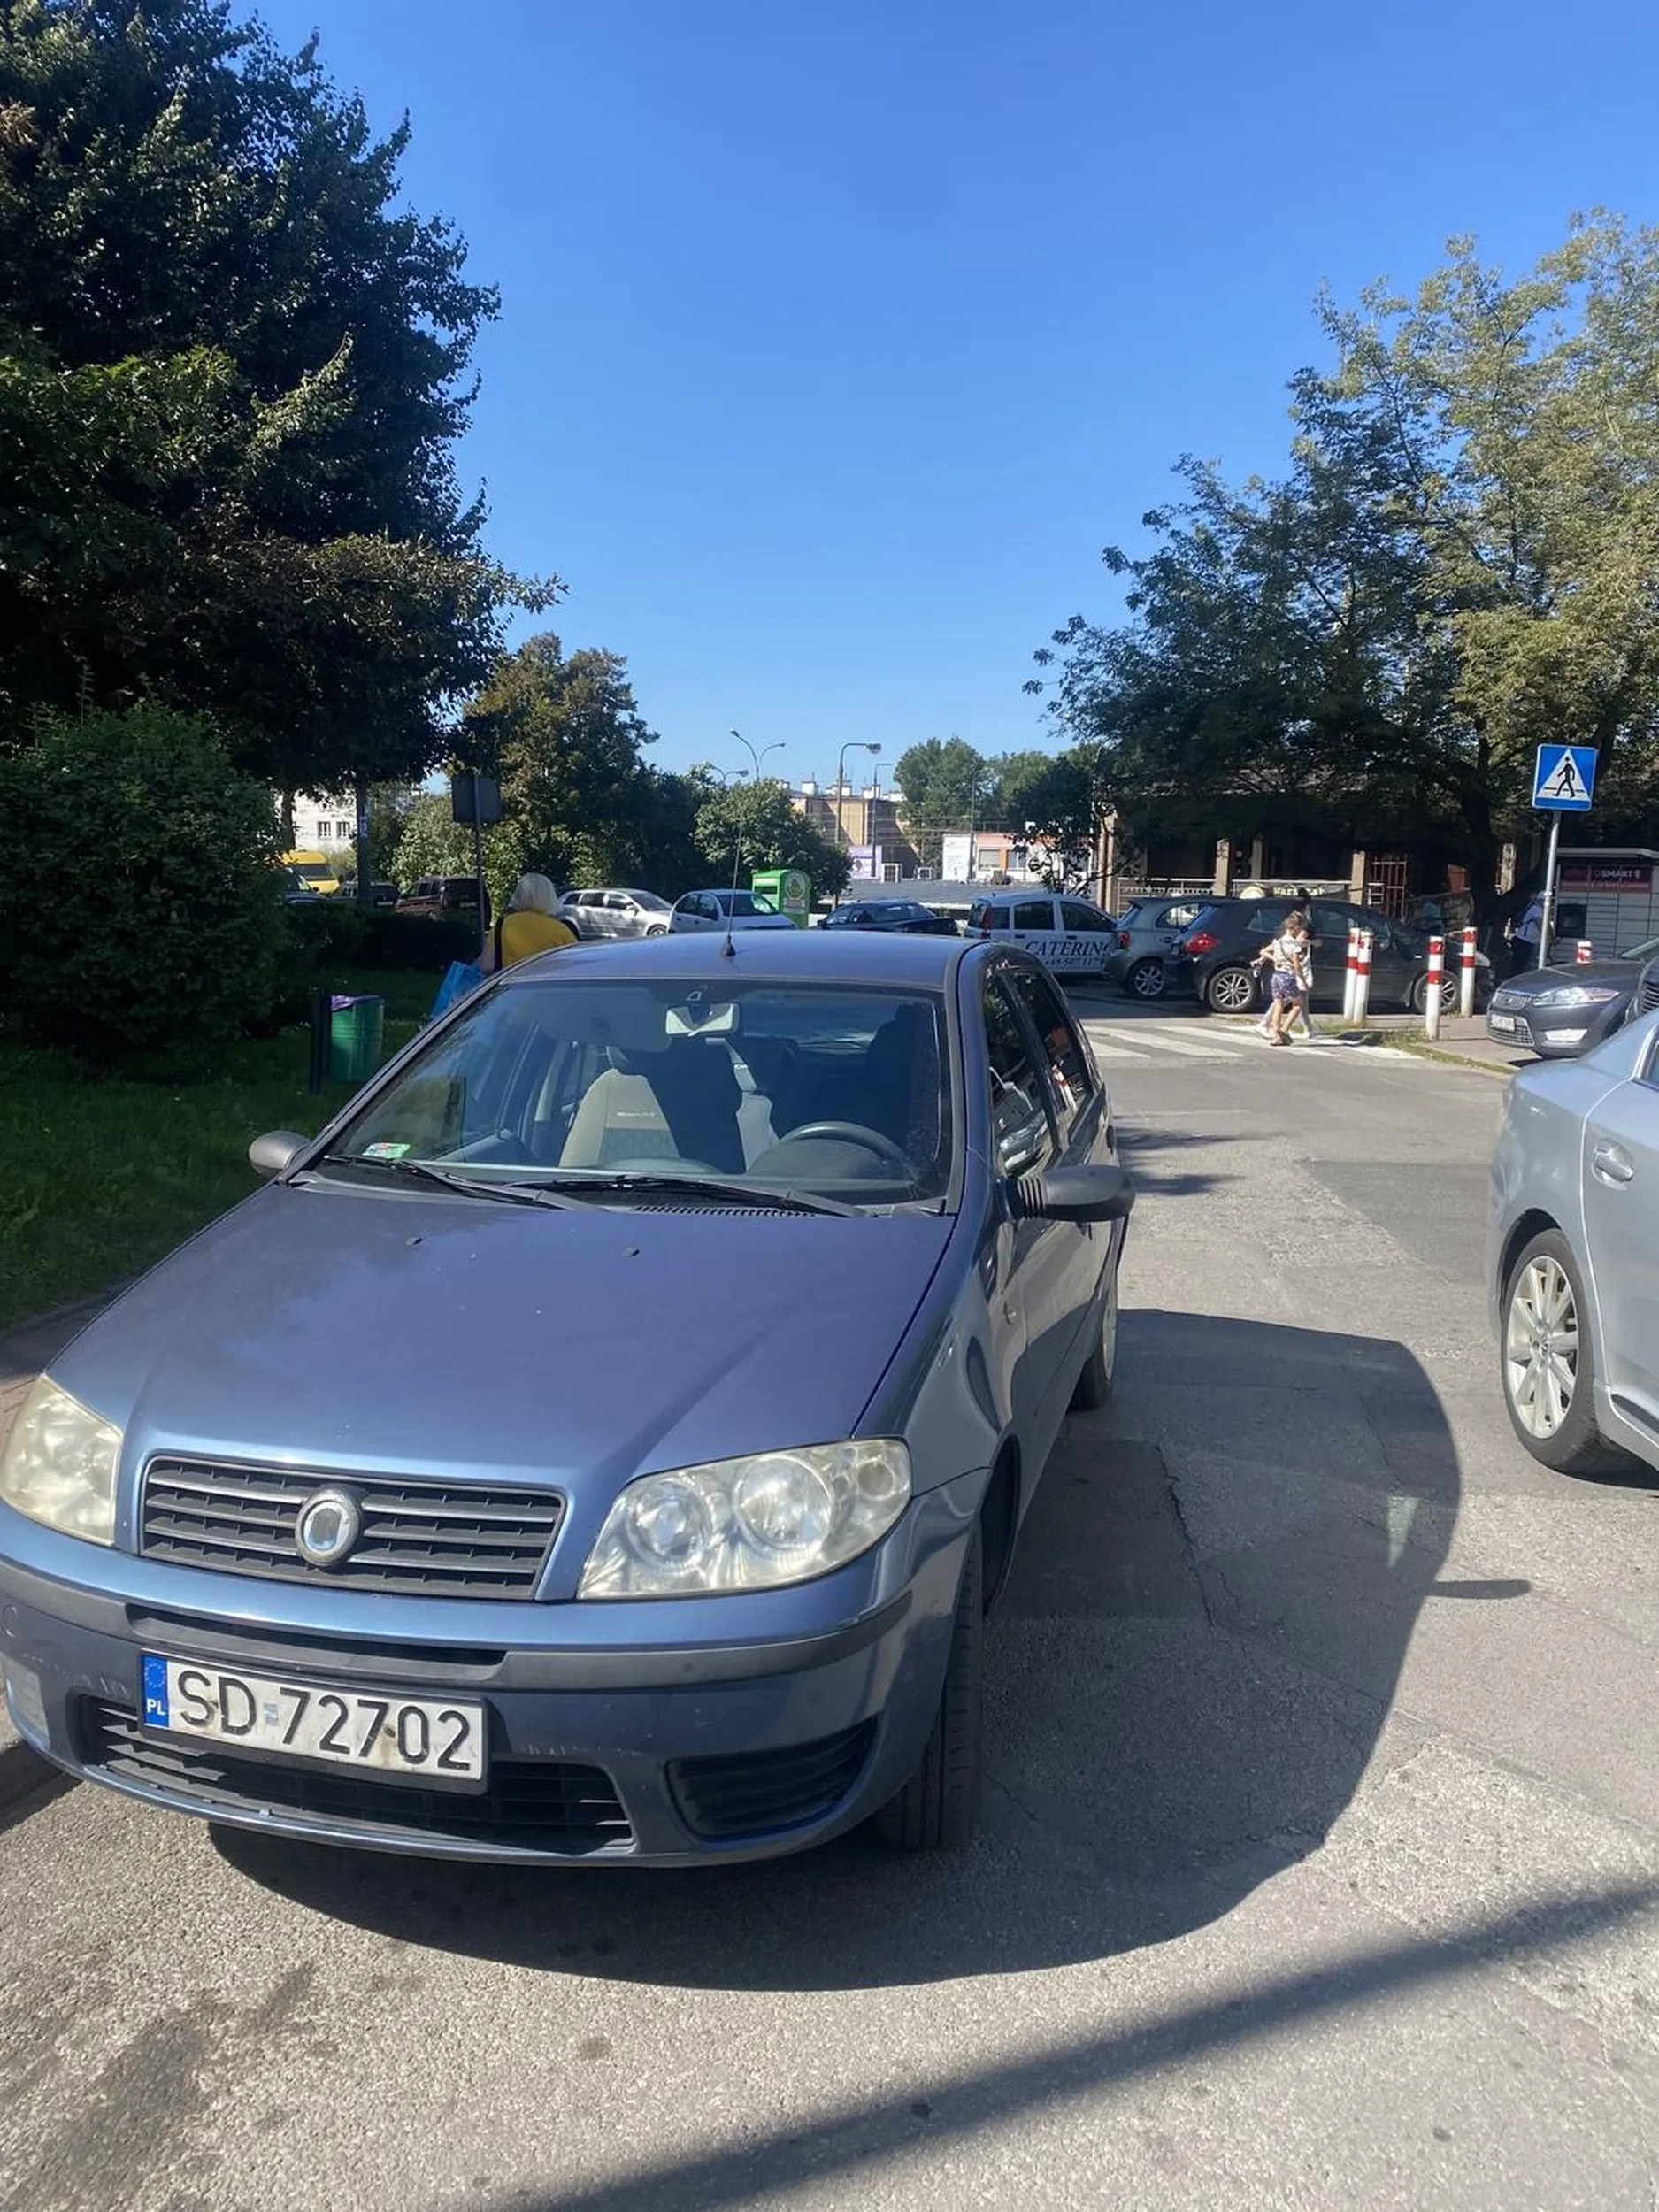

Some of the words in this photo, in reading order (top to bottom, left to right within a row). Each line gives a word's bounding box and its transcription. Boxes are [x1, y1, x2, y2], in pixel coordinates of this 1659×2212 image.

[146, 1698, 166, 1716] PL
[178, 1670, 256, 1737] SD
[279, 1687, 471, 1770] 72702
